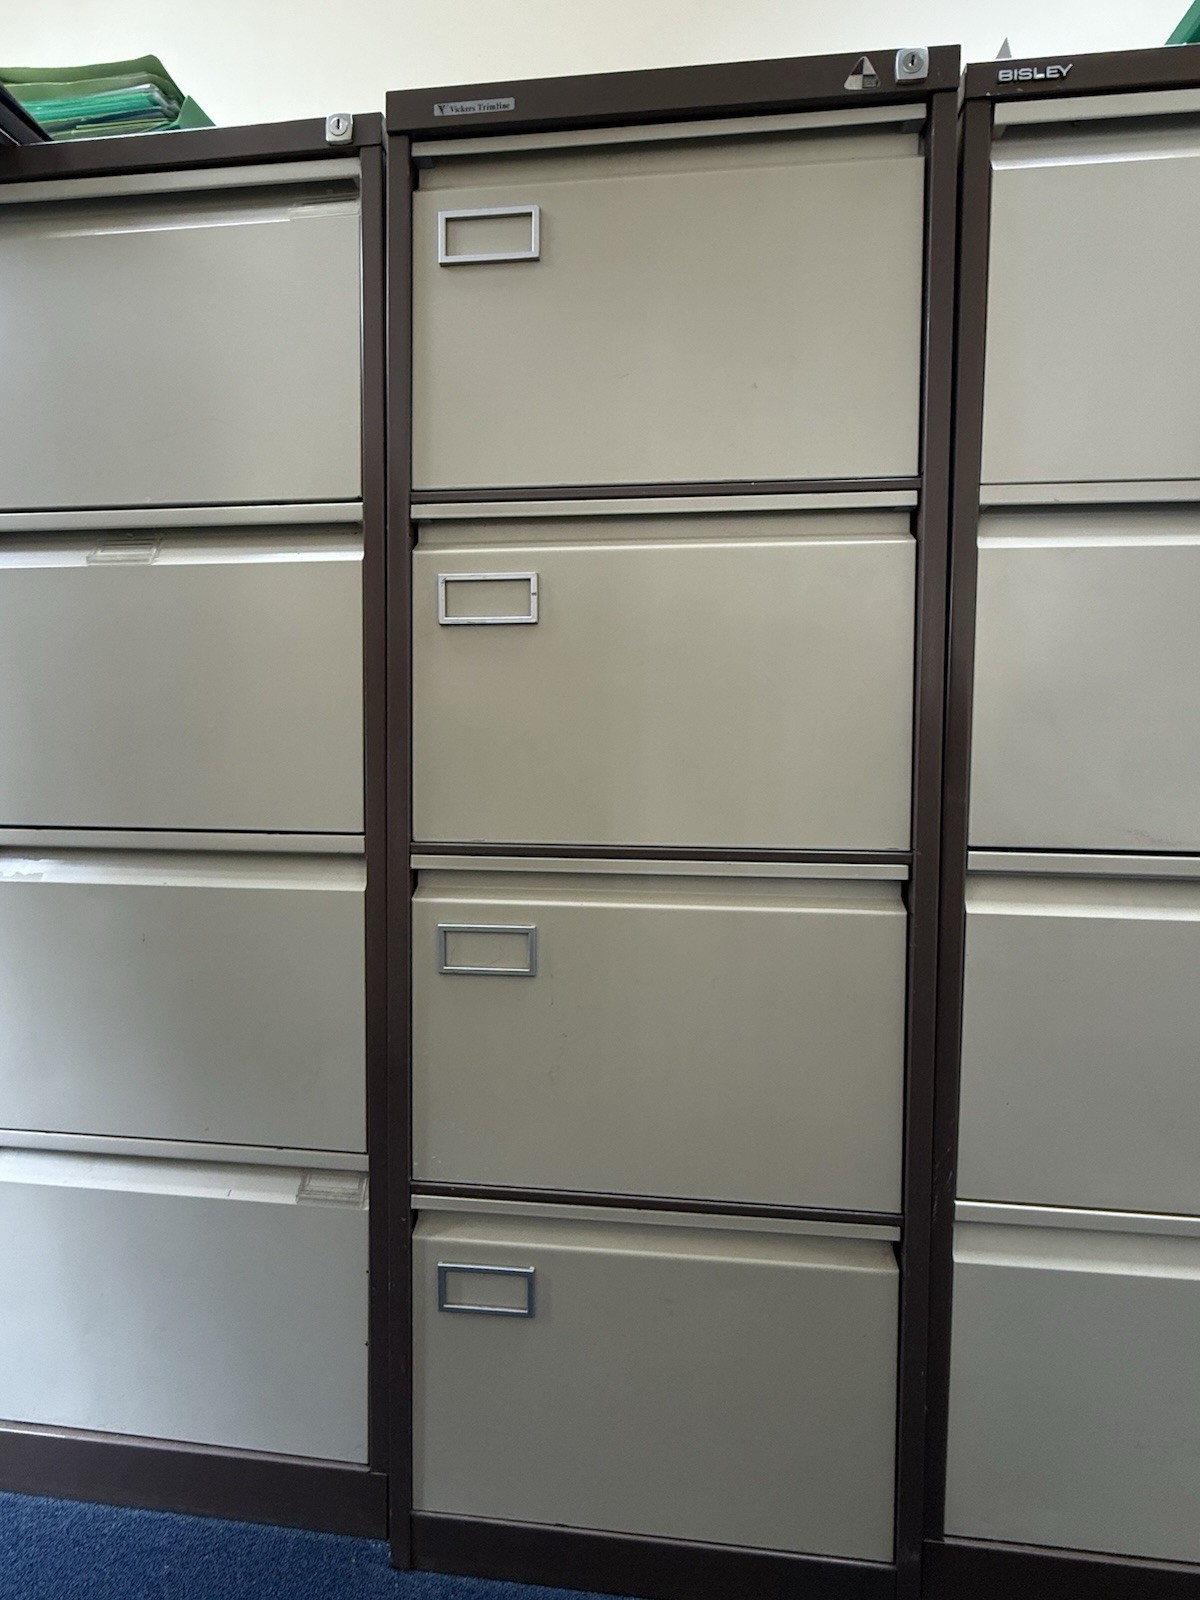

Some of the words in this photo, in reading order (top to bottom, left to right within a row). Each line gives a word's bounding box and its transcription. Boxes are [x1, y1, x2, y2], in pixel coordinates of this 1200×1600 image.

[998, 63, 1073, 82] BISLEY
[450, 104, 476, 113] Vickers
[478, 101, 511, 111] Trimline
